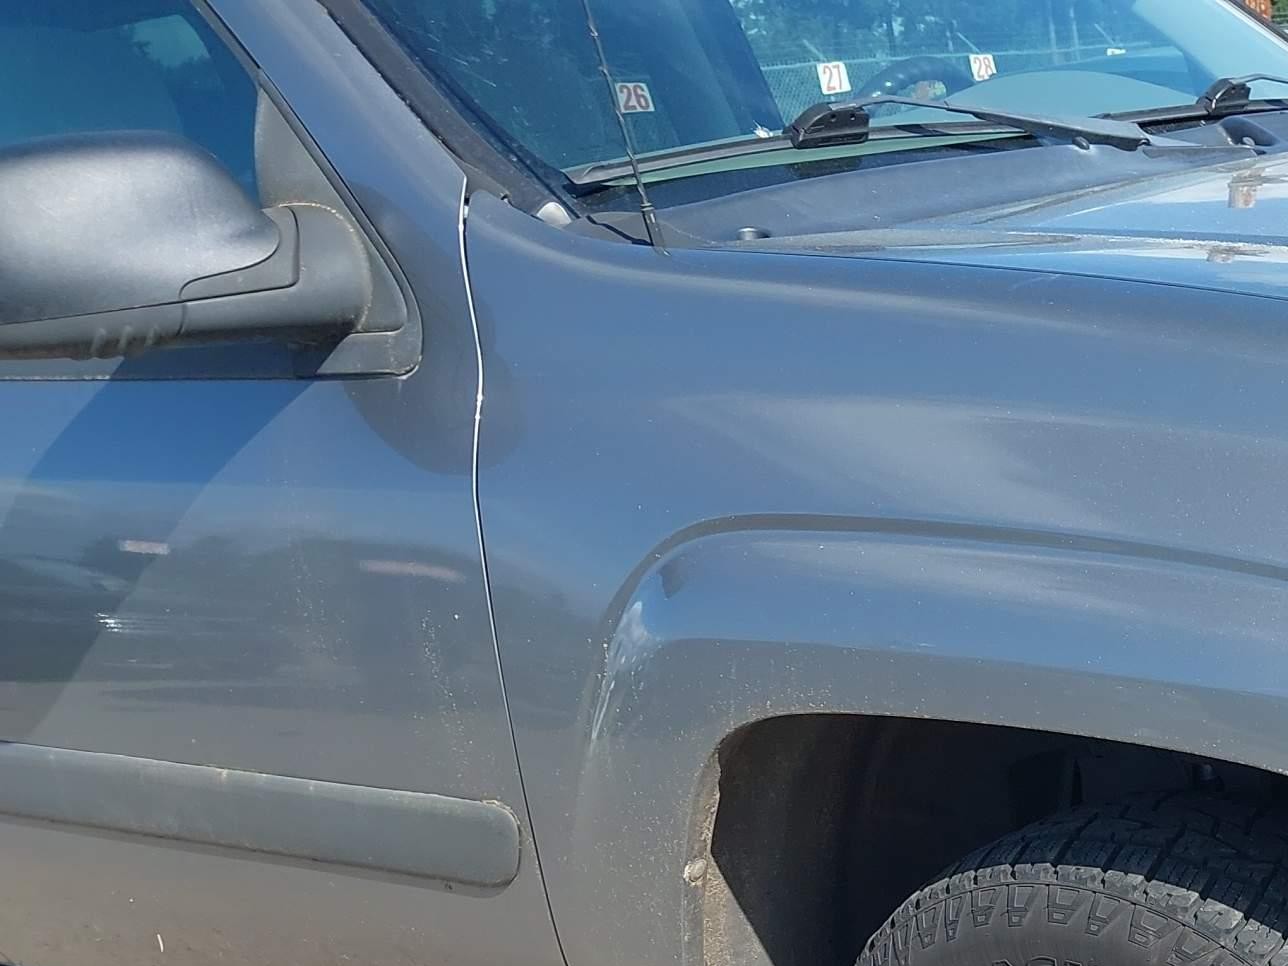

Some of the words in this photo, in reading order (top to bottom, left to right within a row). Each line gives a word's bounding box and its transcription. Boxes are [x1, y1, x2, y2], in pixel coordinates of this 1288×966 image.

[822, 65, 843, 92] 27
[973, 57, 993, 80] 28
[619, 84, 650, 111] 26
